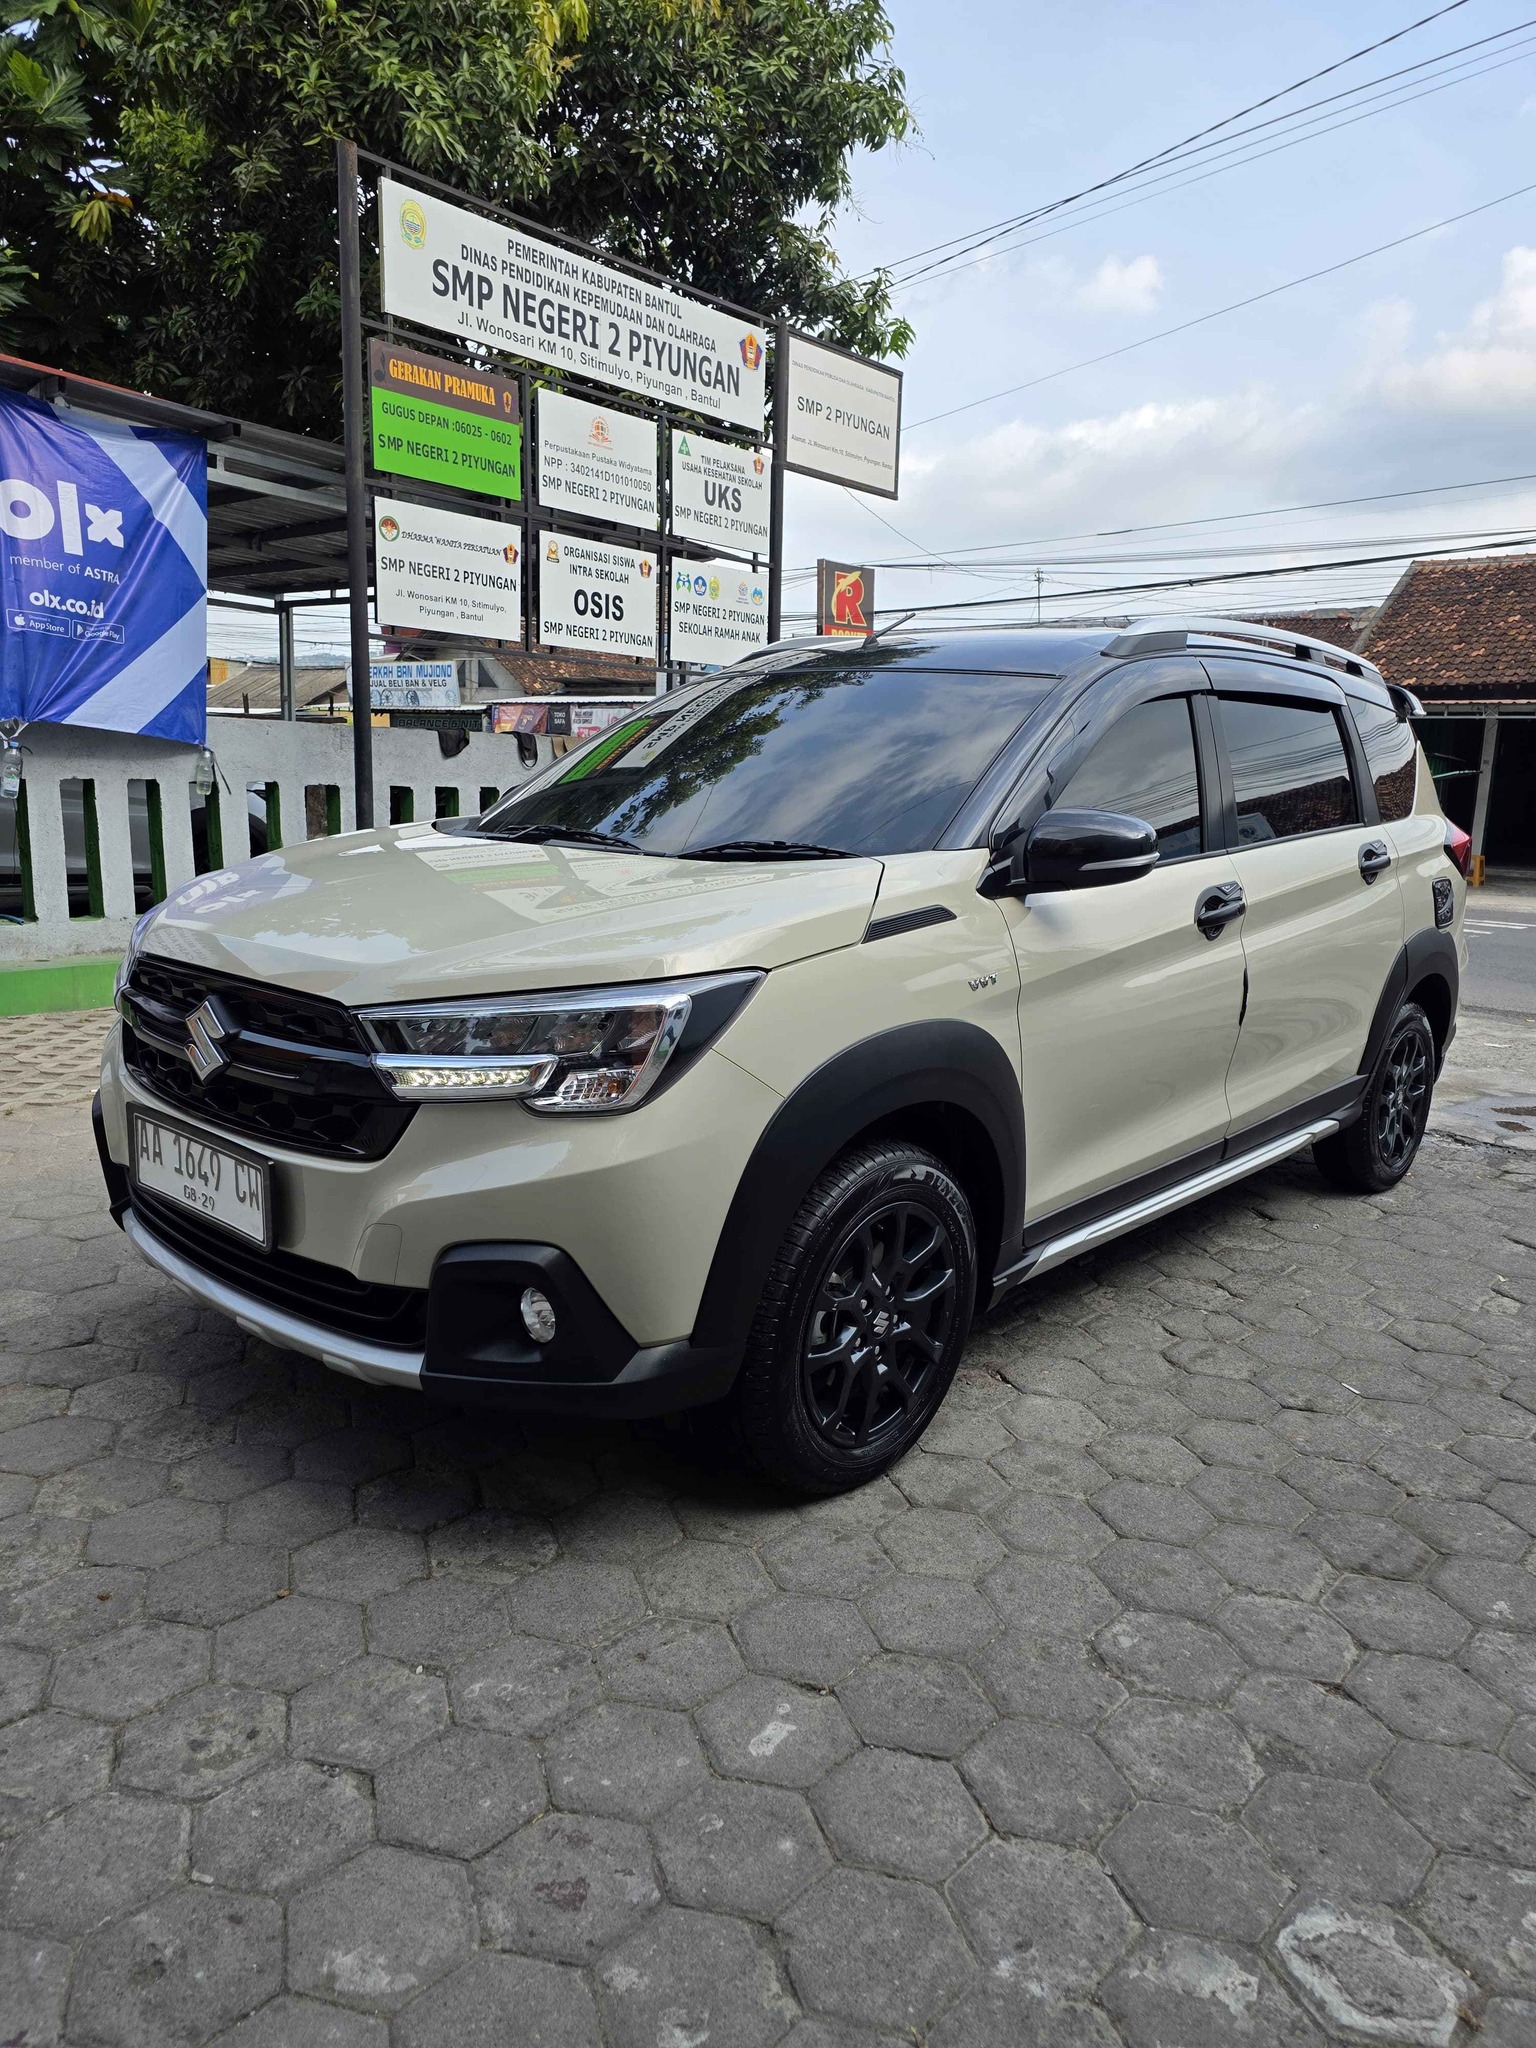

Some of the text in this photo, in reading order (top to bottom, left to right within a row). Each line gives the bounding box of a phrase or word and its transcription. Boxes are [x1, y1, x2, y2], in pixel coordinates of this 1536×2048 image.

[507, 238, 683, 319] PEMERINTAH KABUPATEN BANTUL
[461, 243, 717, 353] DINAS PENDIDIKAN KEPEMUDAAN DAN OLAHRAGA
[432, 258, 740, 397] SMP NEGERI 2 PIYUNGAN
[457, 311, 473, 328] Jl.
[476, 316, 535, 348] Wonosari
[538, 337, 557, 356] KM
[560, 345, 577, 365] 10,
[579, 352, 633, 383] Sitimulyo,
[636, 371, 683, 398] Piyungan
[690, 388, 721, 409] Bantul
[389, 358, 496, 406] GERAKAN PRAMUKA
[382, 402, 415, 420] GUGUS
[418, 412, 449, 429] DEPAN
[452, 421, 482, 438] :06025
[491, 431, 512, 445] 0602
[797, 396, 890, 440] SMP 2 PIYUNGAN
[407, 440, 448, 462] NEGERI
[452, 451, 458, 464] 2
[462, 453, 515, 478] PIYUNGAN
[544, 440, 590, 459] Perpustakaan
[592, 453, 617, 466] Pustaka
[619, 460, 652, 476] Widyatama
[544, 456, 563, 469] NPP
[701, 455, 745, 475] TIM PELAKSANA
[682, 461, 763, 490] USAHA KESEHATAN SEKOLAH
[542, 475, 655, 513] SMP NEGERI 2 PIYUNGAN
[704, 480, 741, 513] UKS
[0, 478, 124, 557] olx
[675, 505, 768, 537] SMP NEGERI 2 PIYUNGAN
[401, 531, 502, 556] DHARMA WANITA PERSATUAN
[564, 546, 636, 569] ORGANISASI SISWA
[10, 555, 120, 585] member of ASTRA
[381, 556, 517, 592] SMP NEGERI 2 PIYUNGAN
[570, 564, 629, 584] INTRA SEKOLAH
[29, 589, 104, 619] olx.co.id
[396, 589, 506, 613] Jl. Wonosari KM 10, Sitimulyo,
[420, 605, 454, 619] Piyungan
[461, 611, 484, 621] Bantul
[574, 589, 624, 622] OSIS
[674, 601, 765, 626] SMP NEGERI 2 PIYUNGAN
[835, 571, 867, 626] R
[85, 630, 120, 640] Google Play
[544, 621, 653, 647] SMP NEGERI 2 PIYUNGAN
[678, 622, 760, 643] SEKOLAH RAMAH ANAK
[369, 664, 452, 679] ERKAH BAN MUJIONO
[370, 680, 387, 688] JUAL
[430, 679, 447, 687] VELG
[140, 1120, 163, 1166] AA
[173, 1135, 221, 1191] 1649
